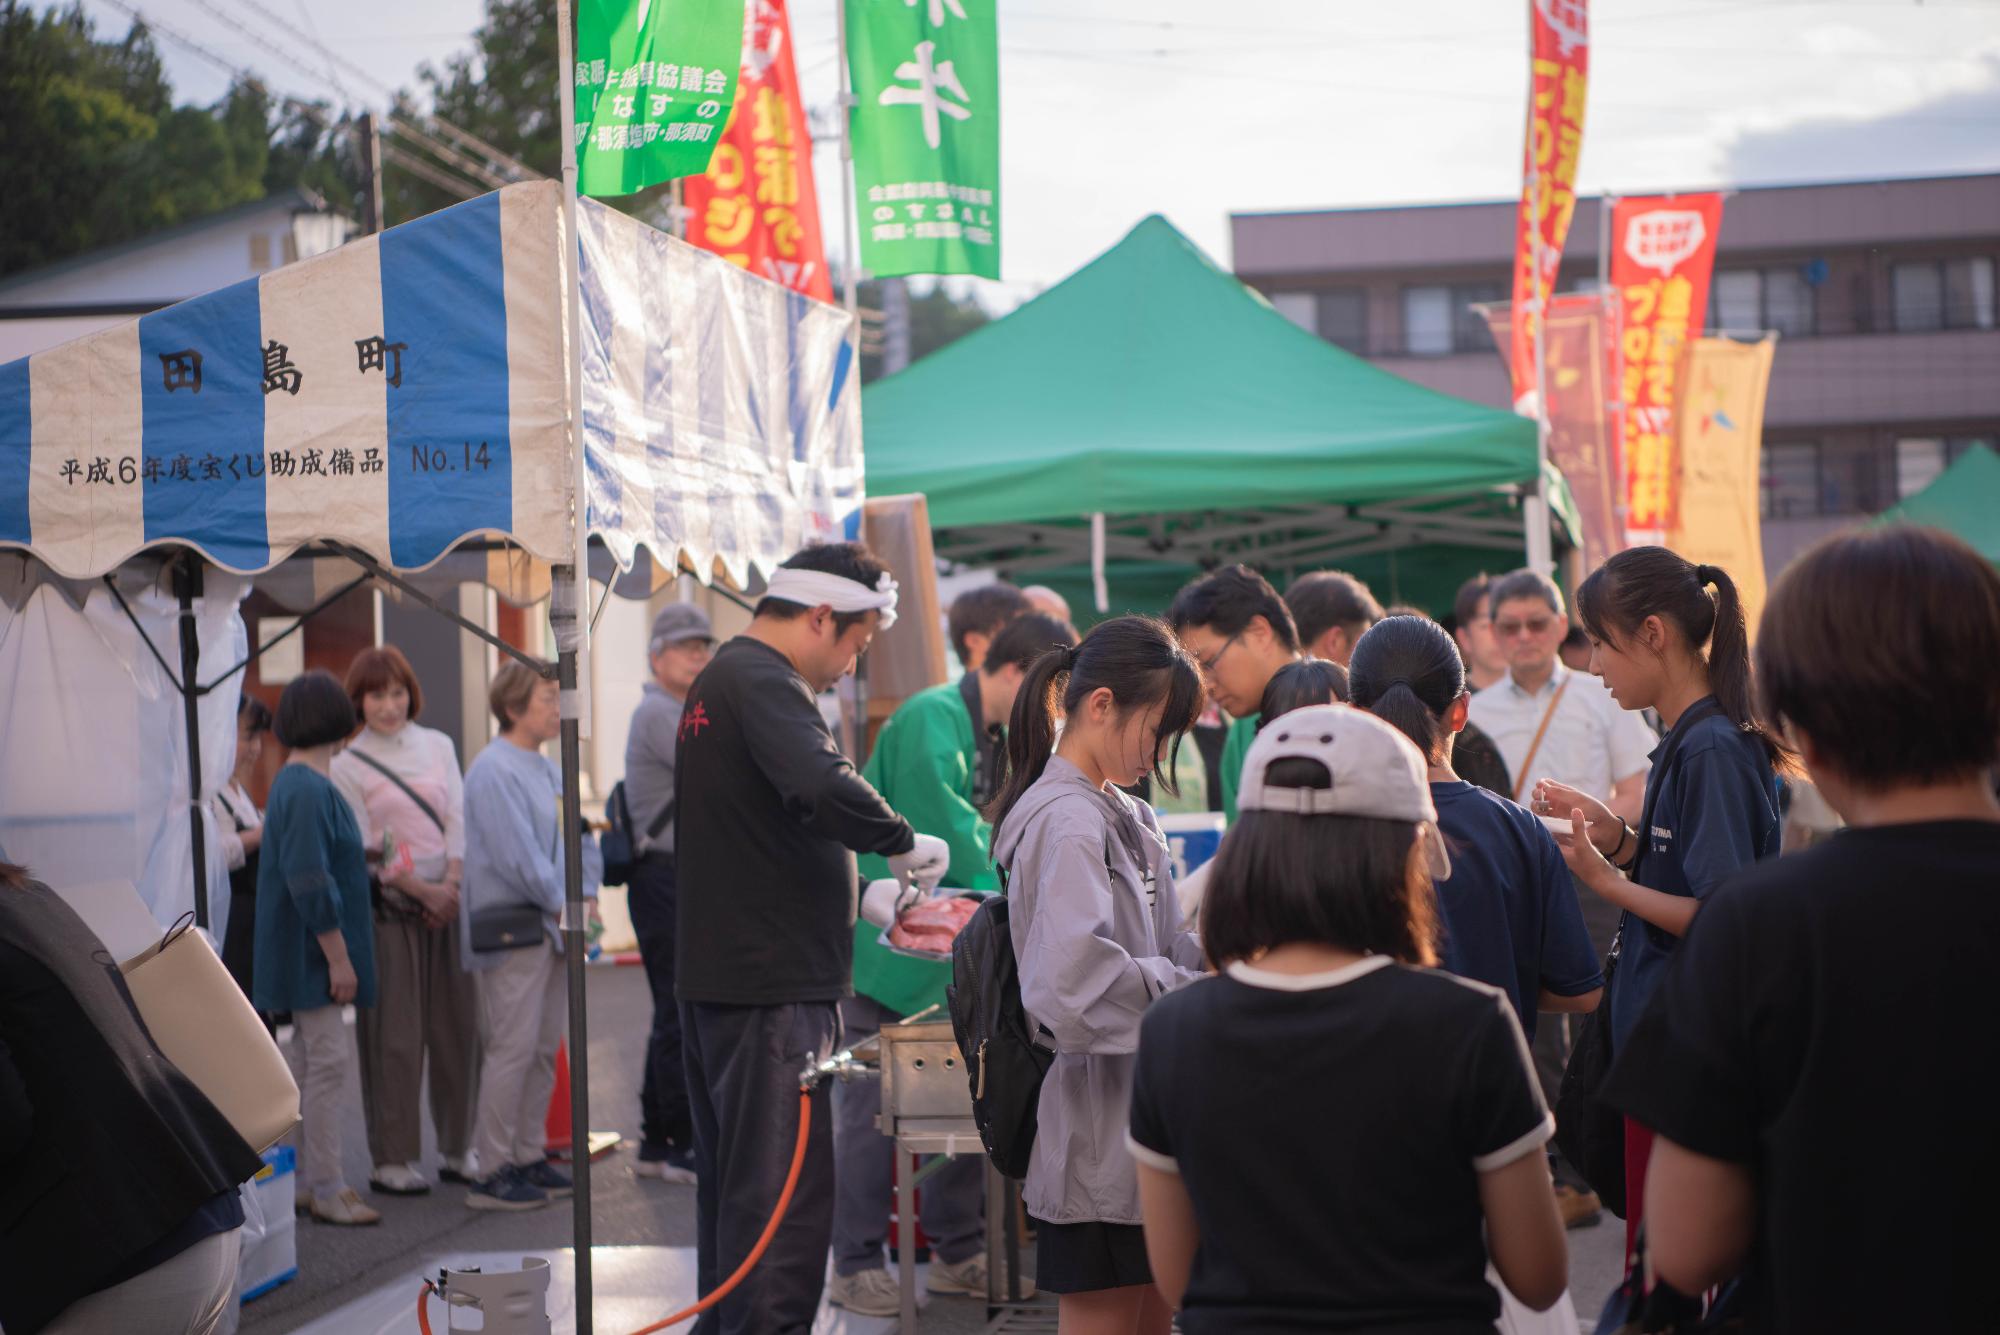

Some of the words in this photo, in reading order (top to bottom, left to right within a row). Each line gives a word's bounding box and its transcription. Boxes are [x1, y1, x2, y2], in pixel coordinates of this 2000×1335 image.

[159, 335, 408, 396] 田島町
[59, 448, 384, 485] 平成6年度宝くじ助成備品
[412, 441, 491, 473] No.14
